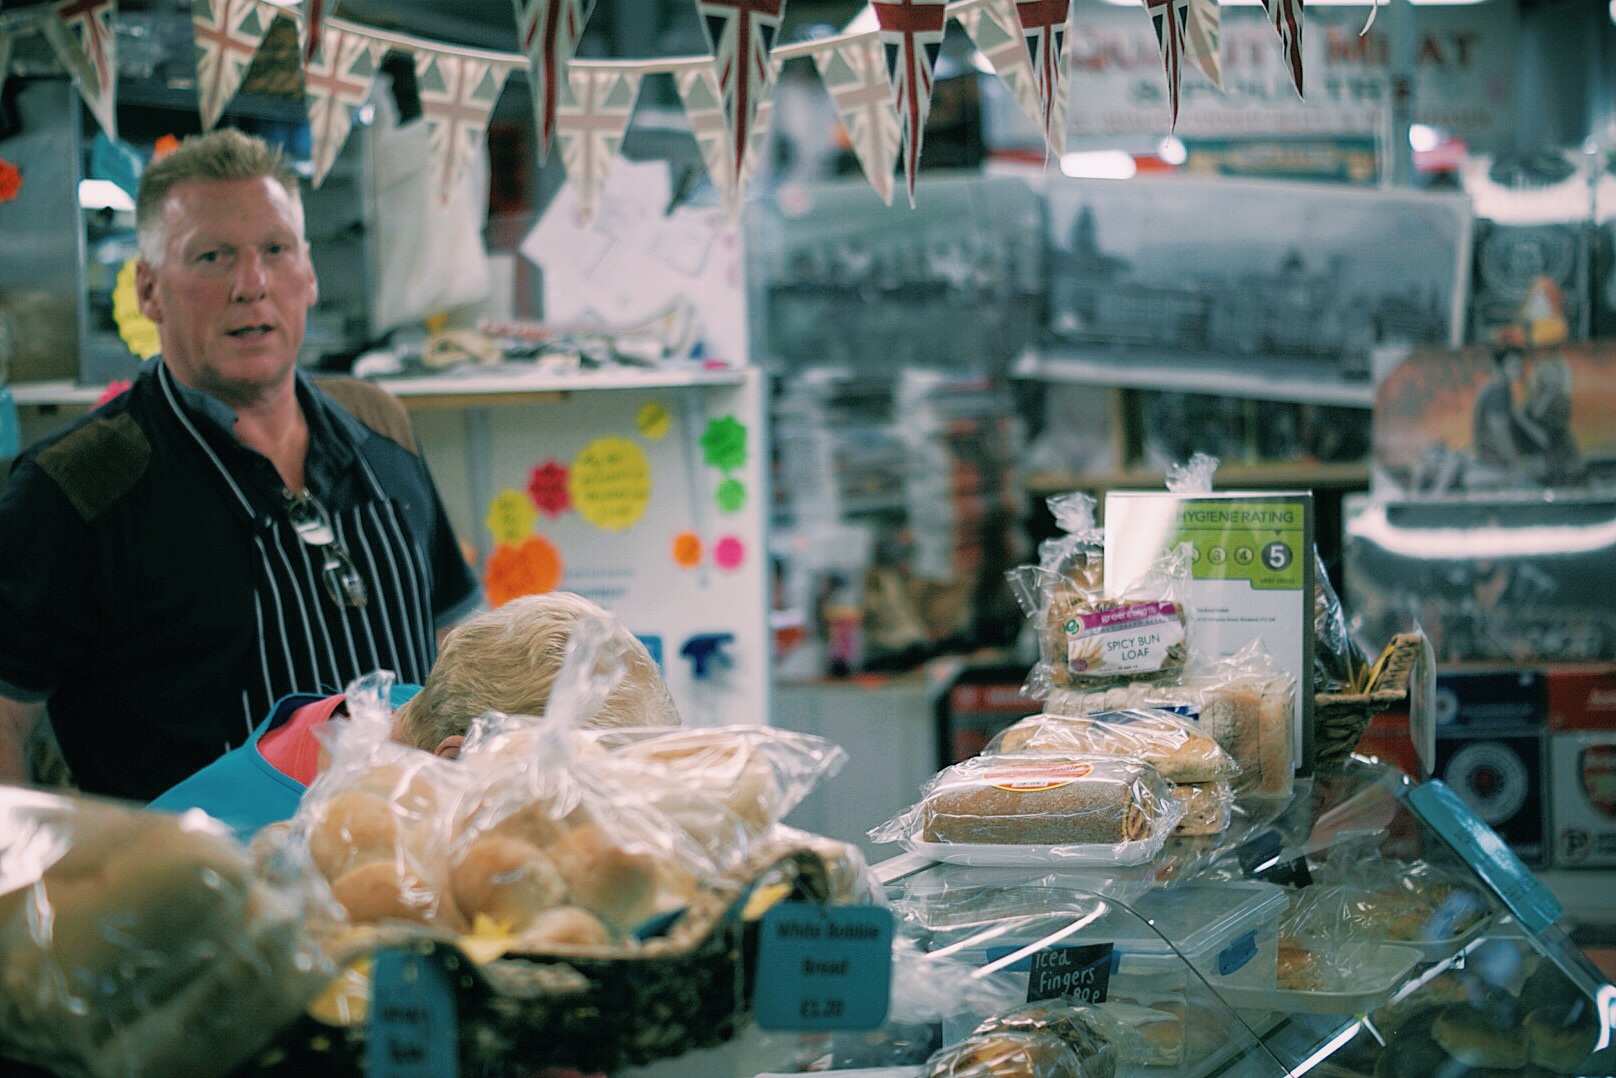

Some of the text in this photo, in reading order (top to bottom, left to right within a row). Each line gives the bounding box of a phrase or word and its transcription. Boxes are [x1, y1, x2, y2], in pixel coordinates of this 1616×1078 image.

[1241, 511, 1294, 523] RATING
[1269, 545, 1285, 568] 5
[1107, 633, 1160, 652] SPICY BUN
[1122, 648, 1150, 661] LOAF
